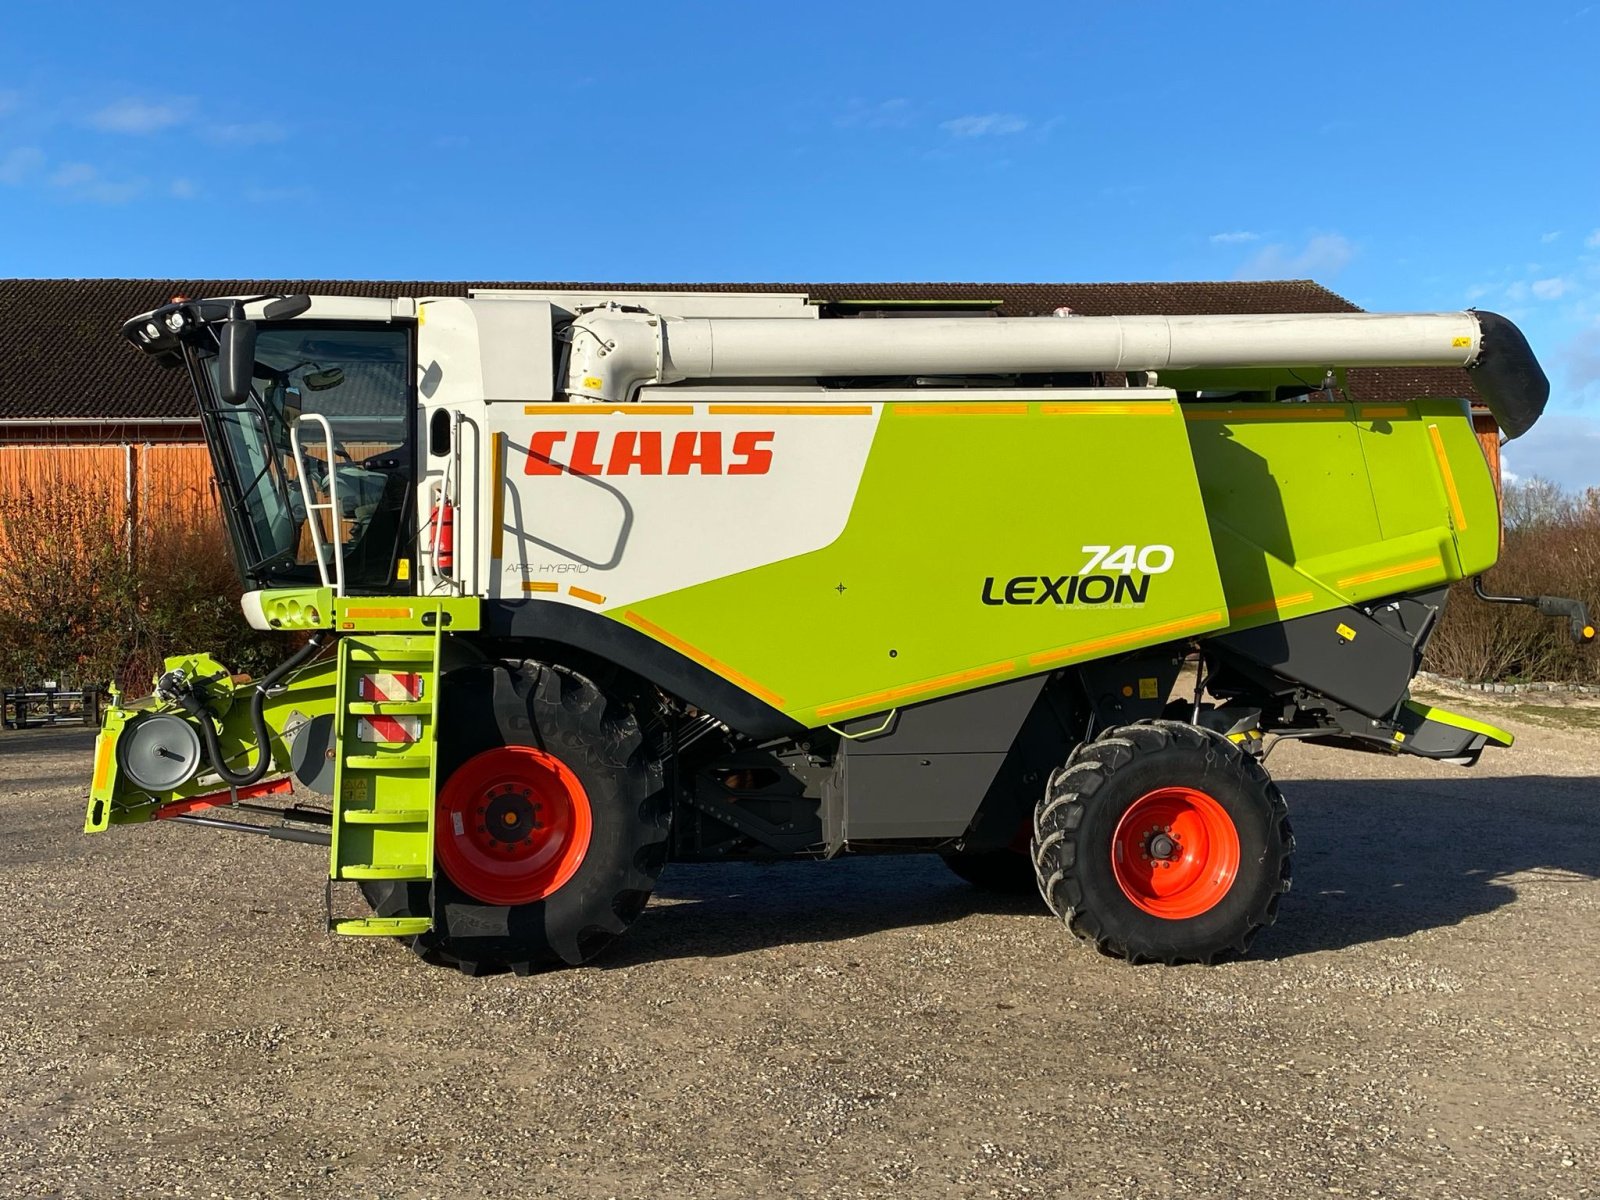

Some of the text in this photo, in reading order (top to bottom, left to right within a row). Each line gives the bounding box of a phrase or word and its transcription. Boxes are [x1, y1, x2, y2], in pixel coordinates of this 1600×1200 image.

[524, 431, 775, 475] CLAAS
[505, 563, 589, 573] APS HYBRID
[1078, 544, 1175, 575] 740
[981, 575, 1151, 606] LEXION
